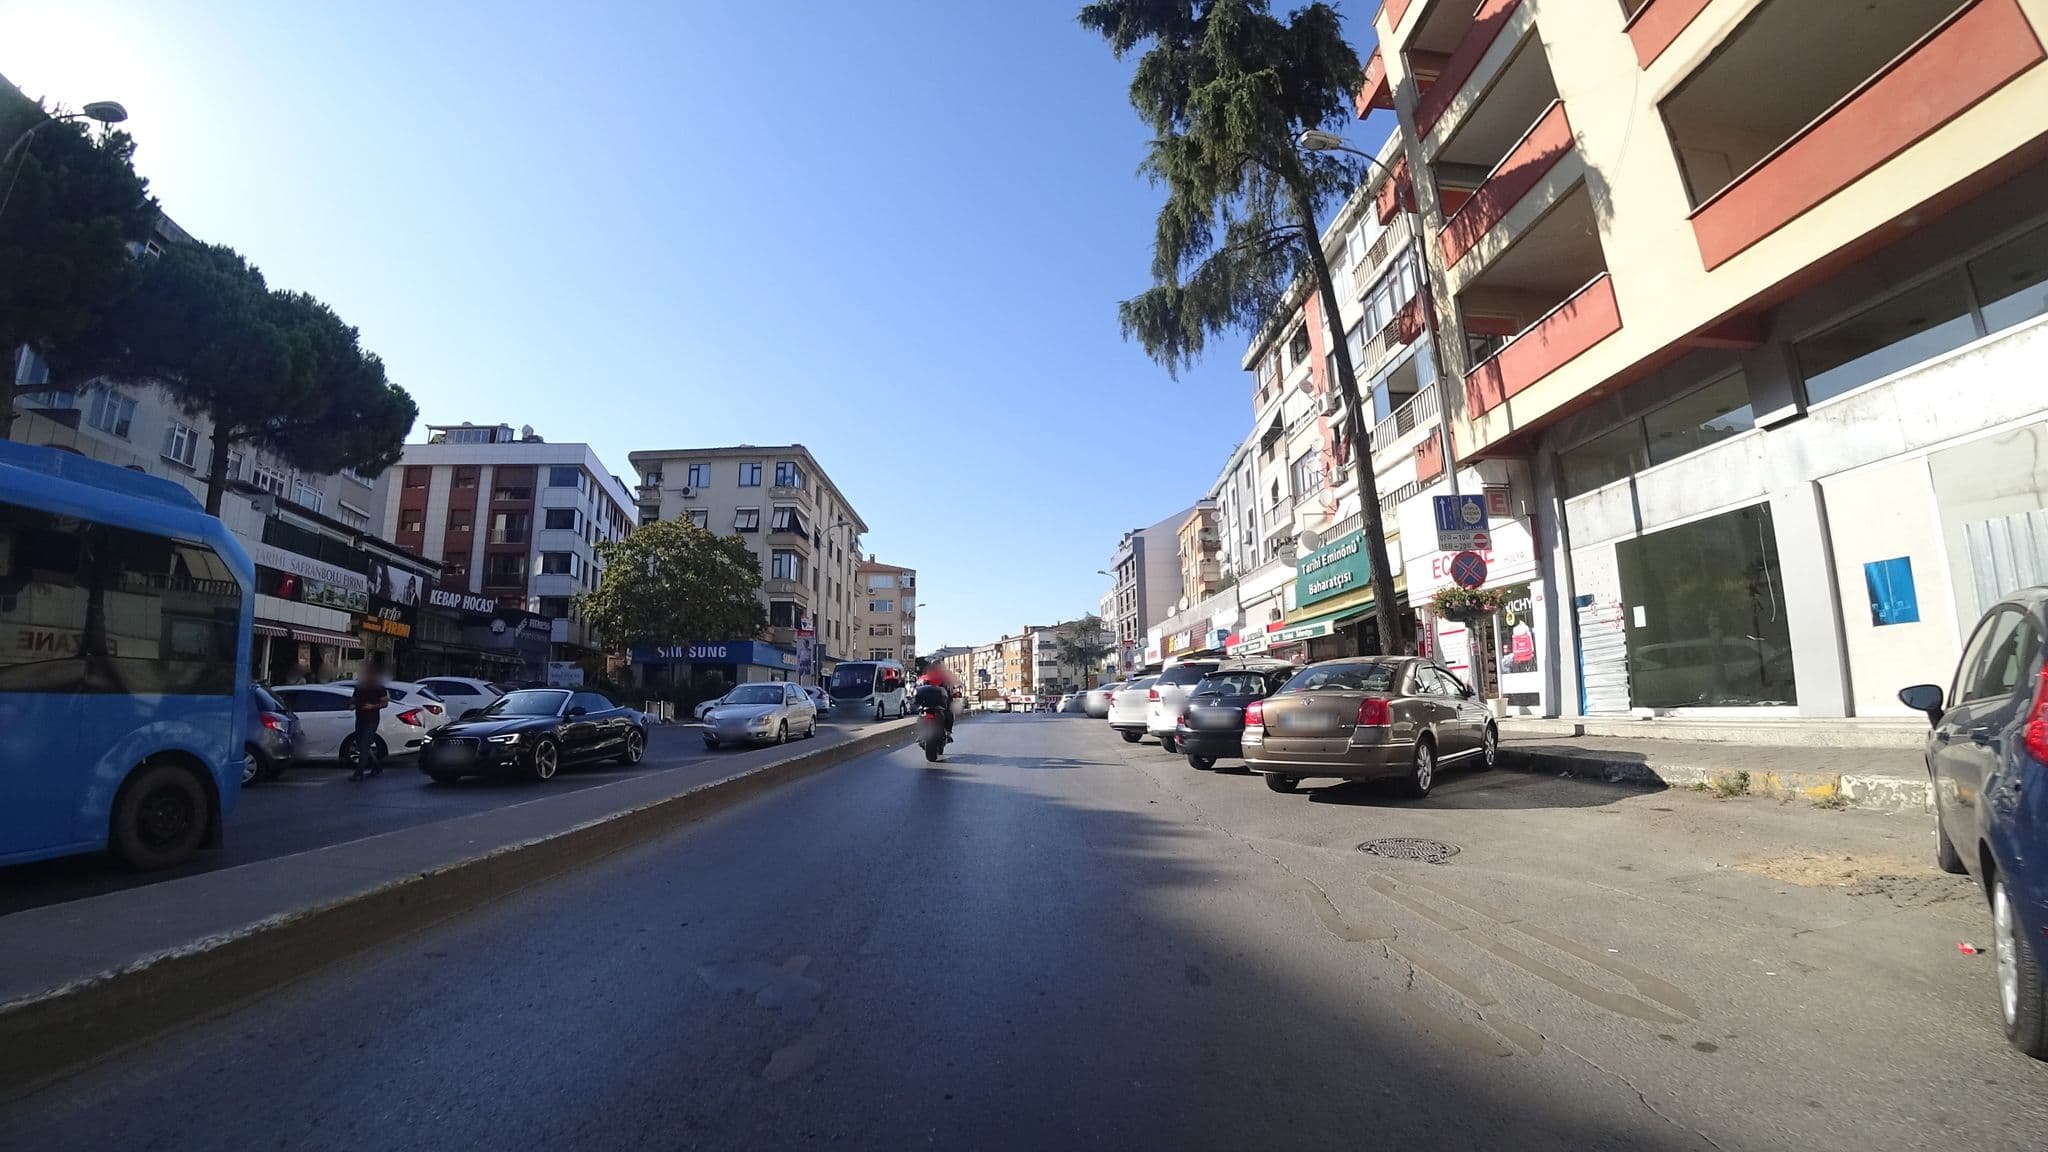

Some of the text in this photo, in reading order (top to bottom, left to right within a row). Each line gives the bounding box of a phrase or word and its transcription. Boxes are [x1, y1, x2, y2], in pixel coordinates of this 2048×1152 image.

[1302, 541, 1357, 575] Tarihi Eminönü
[1432, 549, 1494, 579] ECE
[1309, 570, 1352, 595] Baharatçısı
[430, 589, 494, 613] KEBAP HOCASI
[1504, 597, 1532, 612] VICHY
